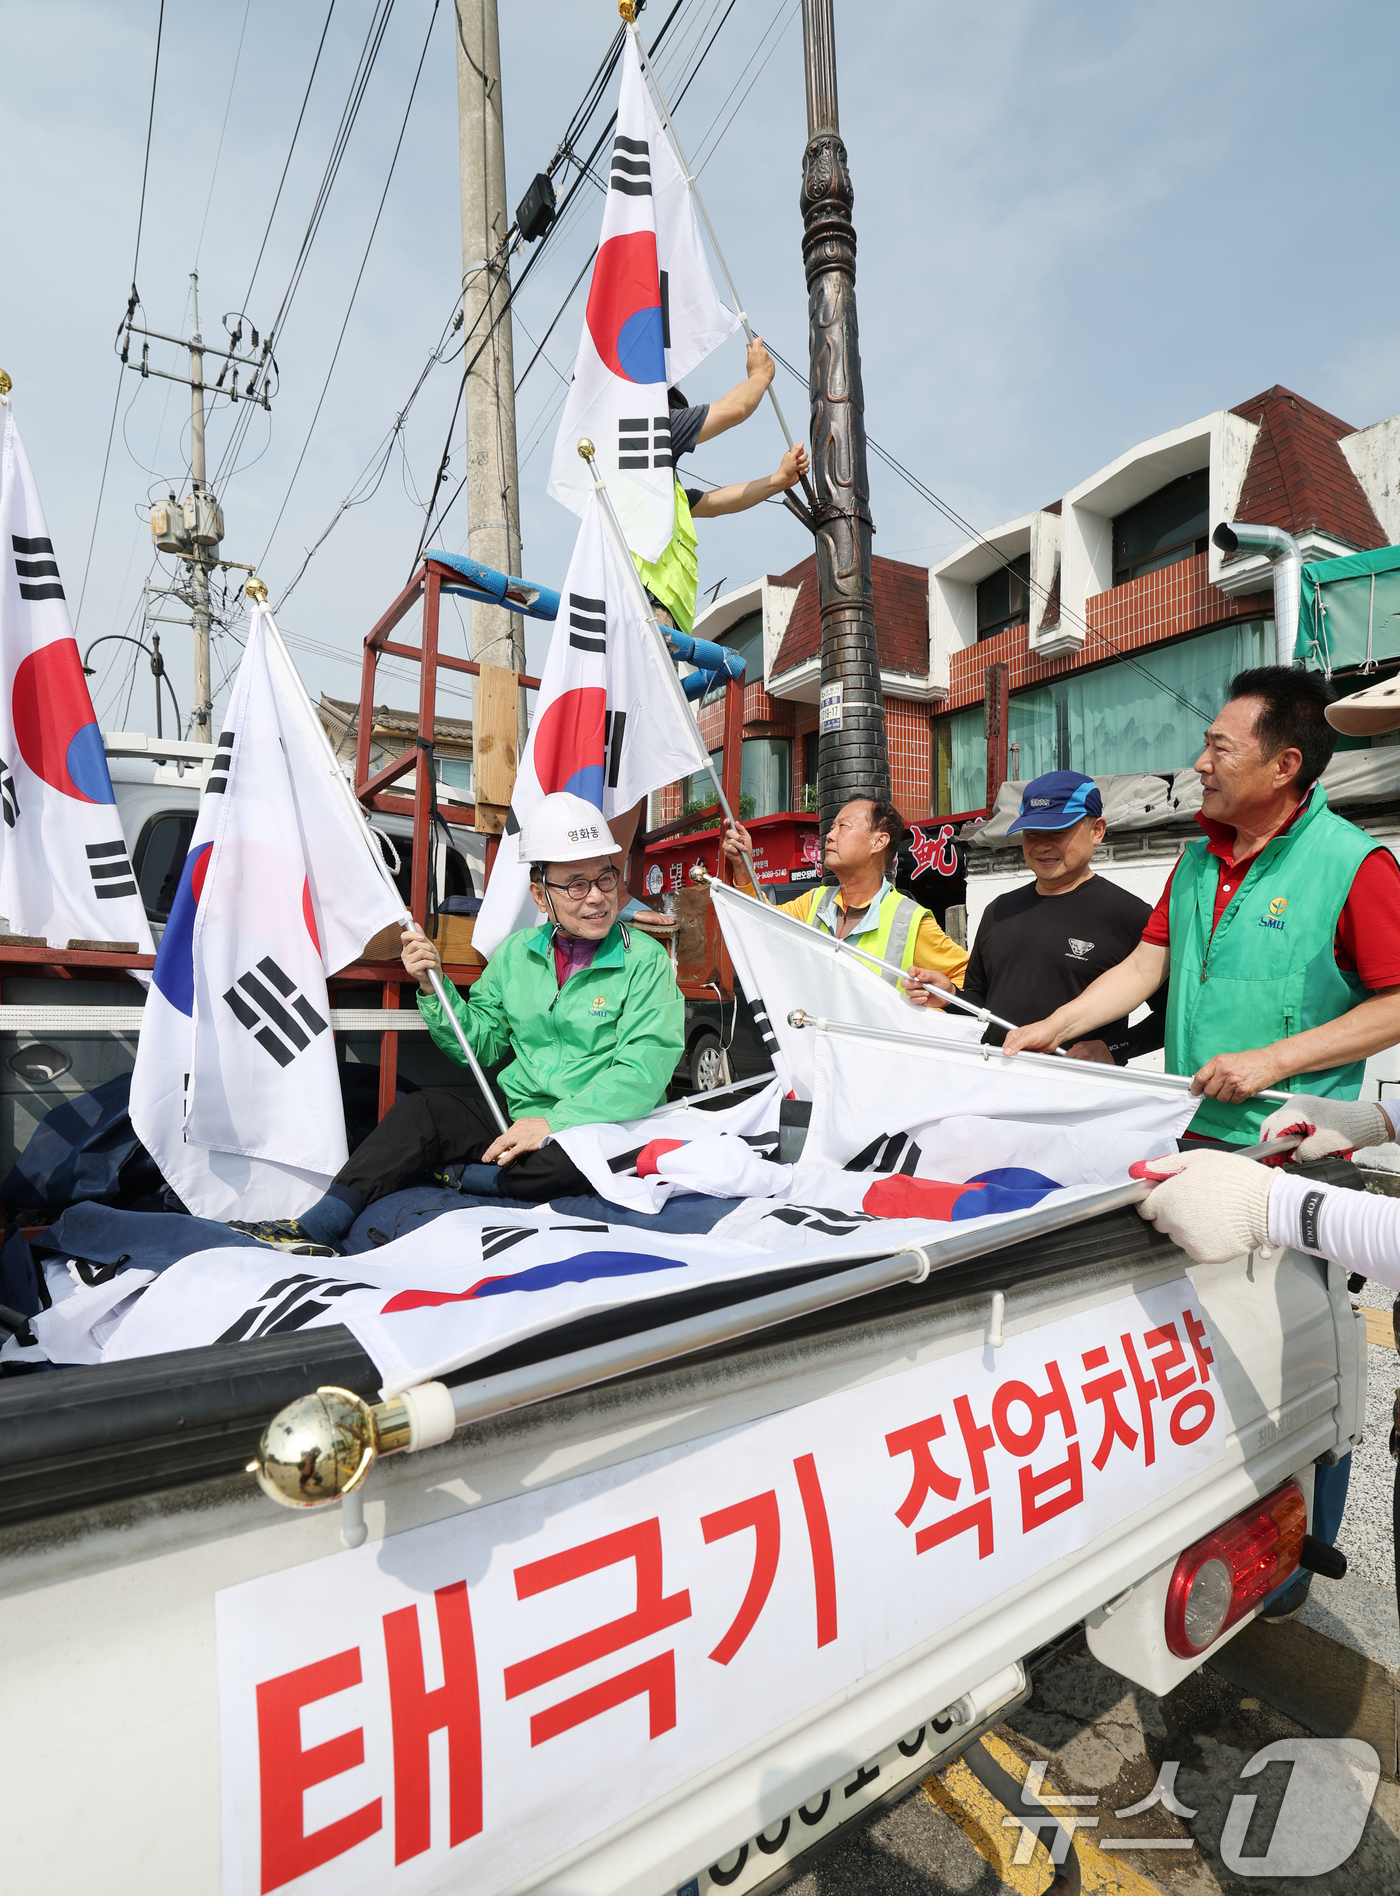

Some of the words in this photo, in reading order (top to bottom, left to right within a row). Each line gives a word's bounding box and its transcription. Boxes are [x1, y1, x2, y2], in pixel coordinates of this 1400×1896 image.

[568, 827, 599, 842] 영화동
[1258, 916, 1285, 931] SMU
[587, 1010, 607, 1018] SMU
[1306, 1196, 1319, 1217] TOP
[1306, 1219, 1317, 1244] COOL
[256, 1453, 838, 1896] 태극기
[885, 1309, 1216, 1561] 작업차량
